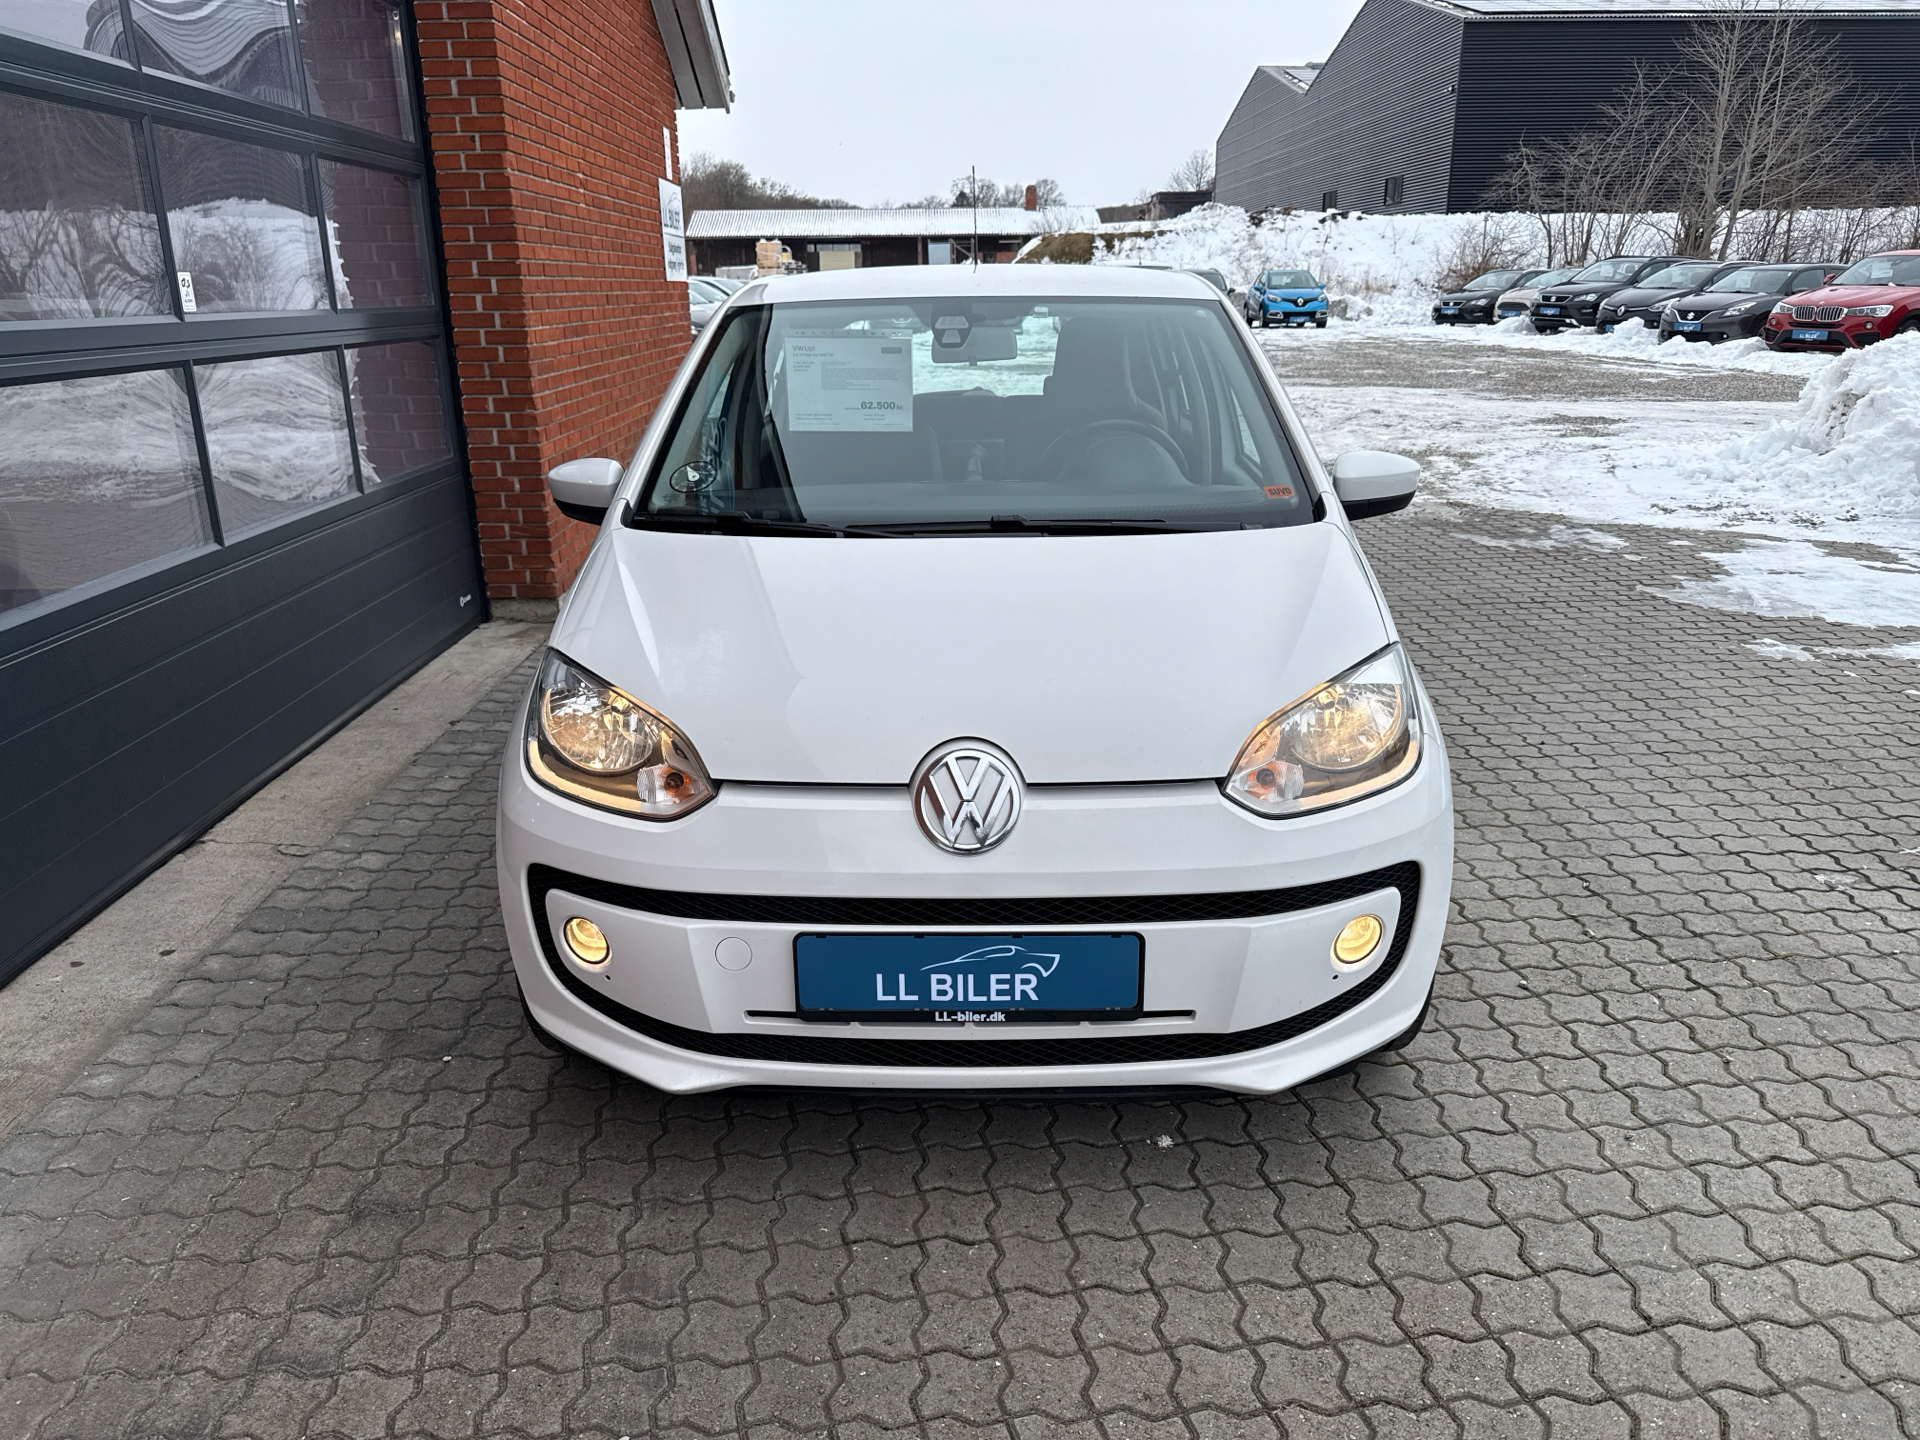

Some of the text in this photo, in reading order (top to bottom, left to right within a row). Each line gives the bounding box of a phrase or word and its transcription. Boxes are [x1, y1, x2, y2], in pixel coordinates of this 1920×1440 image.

[860, 401, 896, 410] 62.500
[876, 973, 1039, 1002] LL BILER
[934, 1011, 1006, 1022] LL-biler.dk
